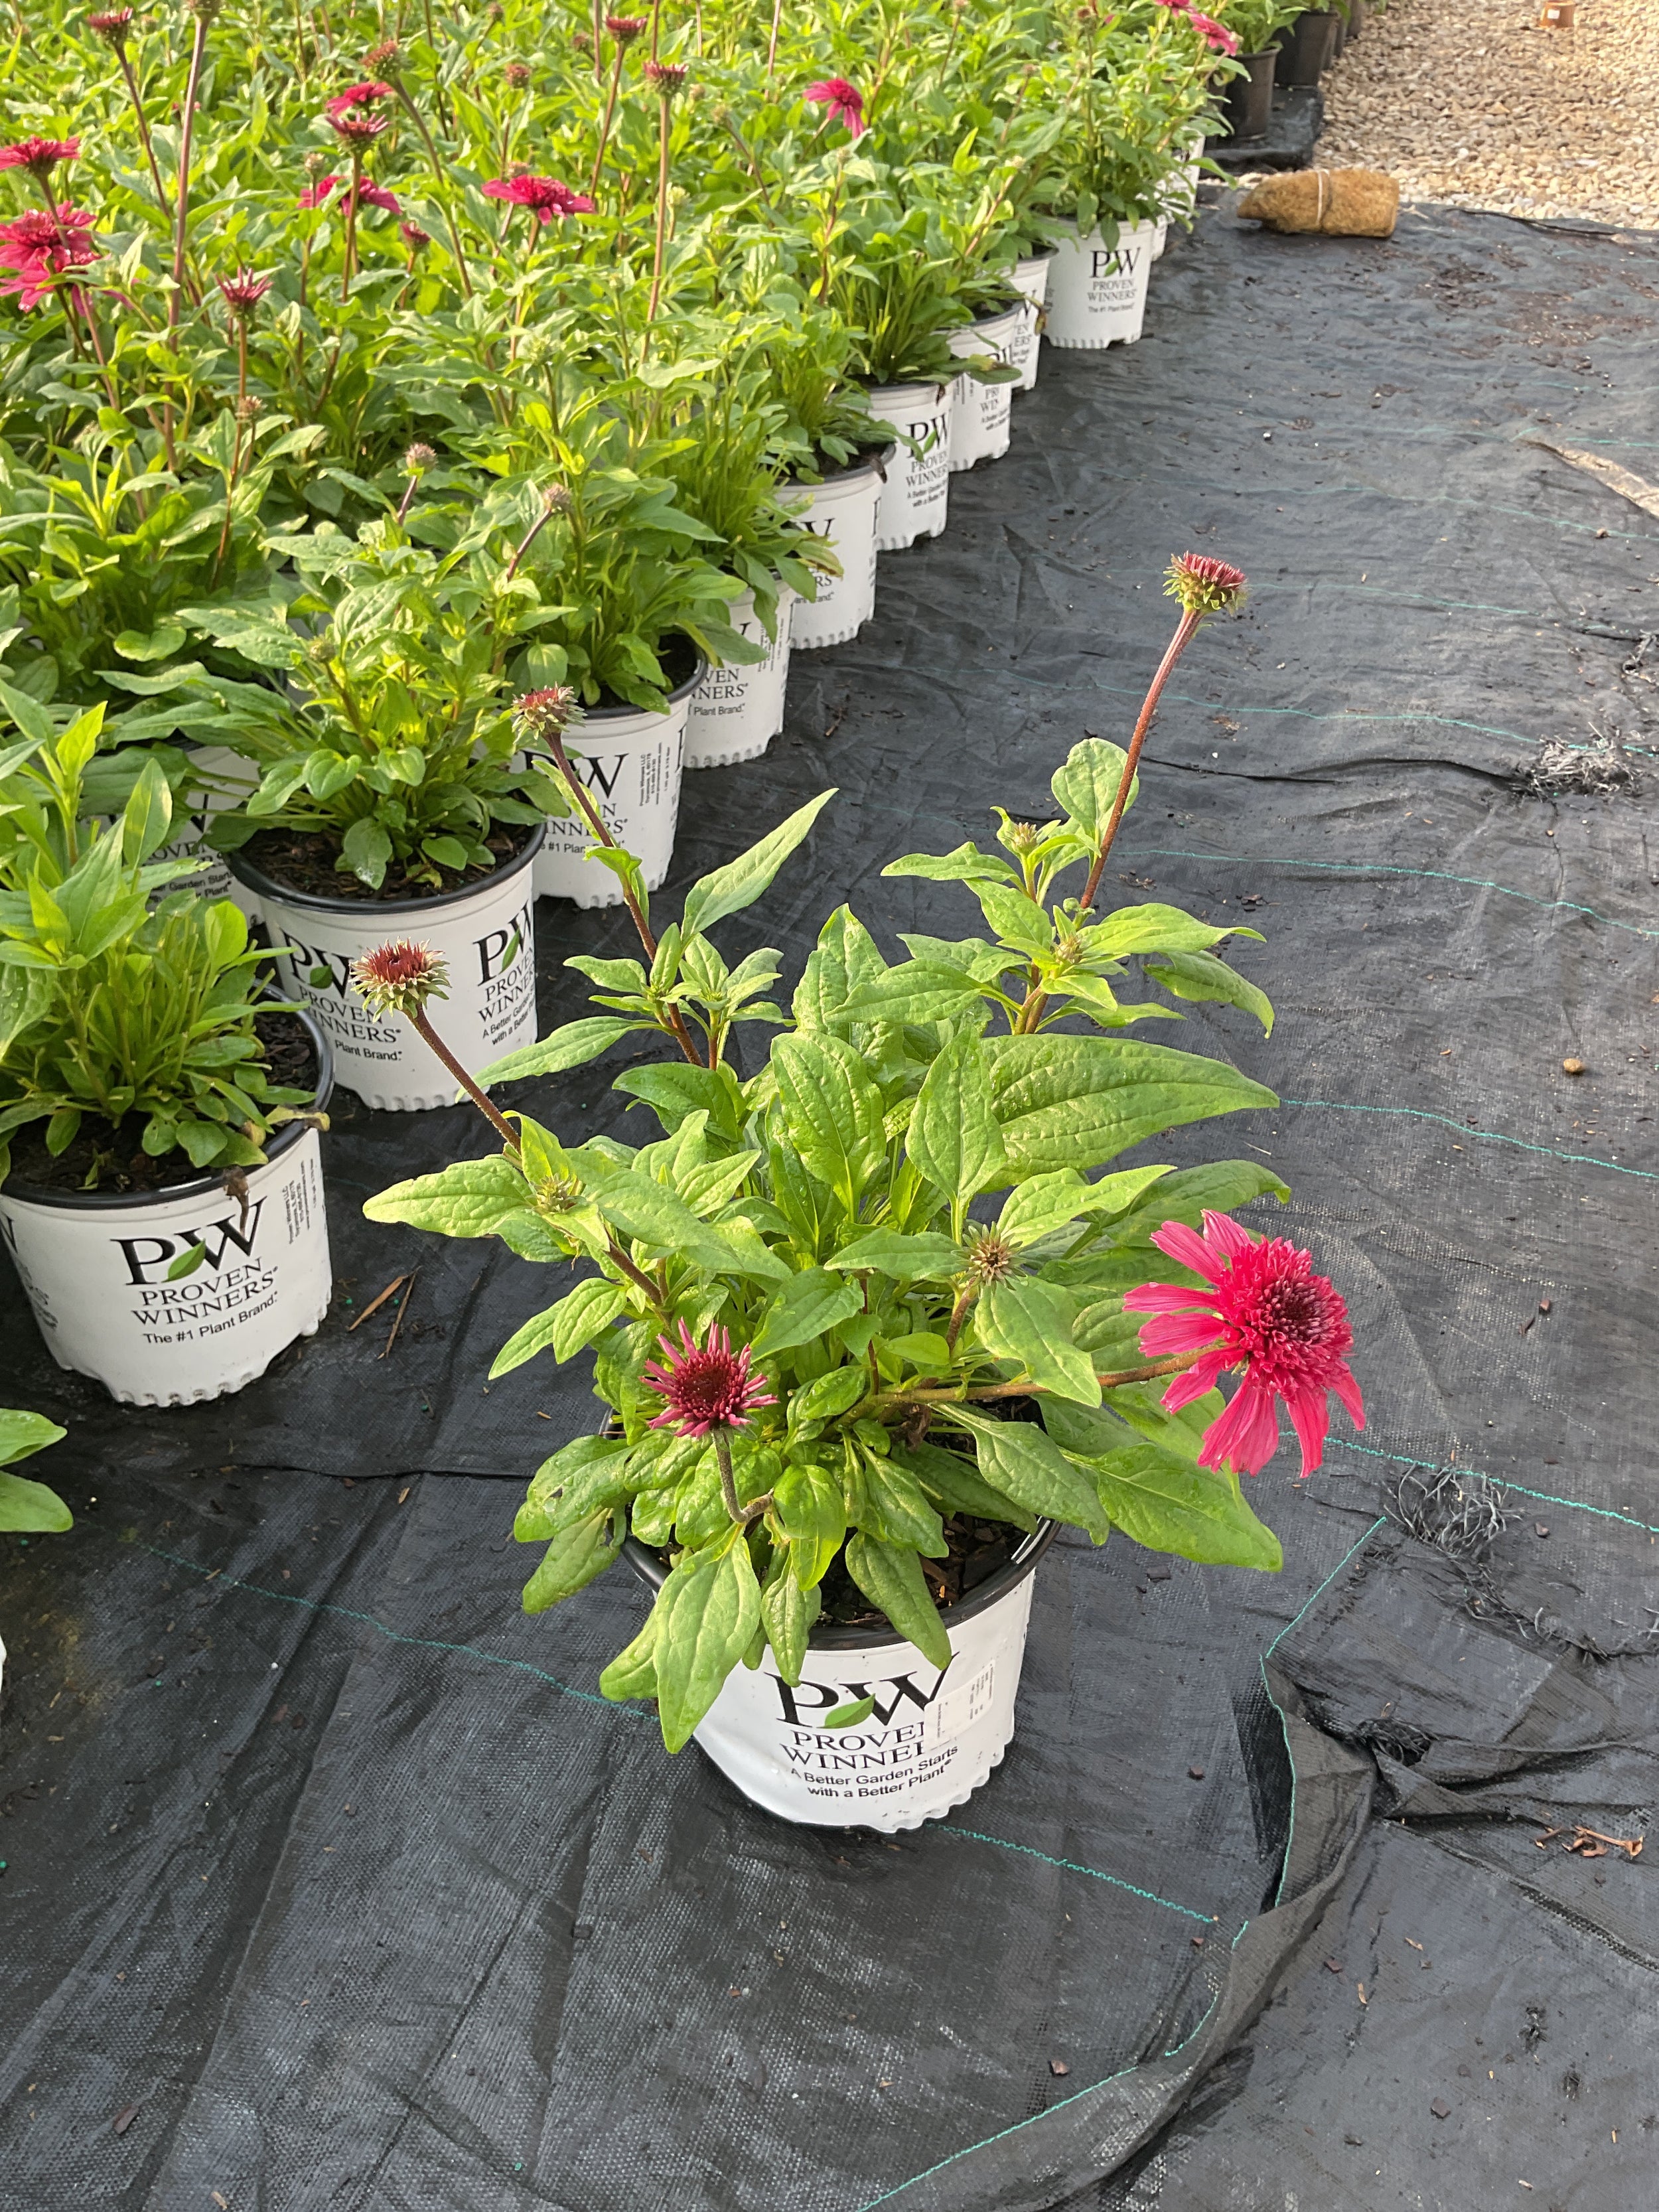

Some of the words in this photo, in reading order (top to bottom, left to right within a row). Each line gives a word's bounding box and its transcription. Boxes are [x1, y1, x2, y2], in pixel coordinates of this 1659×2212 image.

[1090, 246, 1141, 279] PW
[705, 668, 740, 683] VEN
[692, 684, 745, 700] NERS
[564, 844, 586, 853] Plan
[308, 1006, 398, 1043] INNERS
[482, 1029, 490, 1039] A
[490, 1013, 512, 1034] Better
[492, 1031, 507, 1045] with
[334, 1039, 361, 1057] Plant
[110, 1196, 267, 1286] PW
[139, 1256, 262, 1307] PROVEN
[143, 1333, 173, 1344] The
[176, 1330, 194, 1342] #1
[199, 1317, 236, 1337] Plant
[764, 1651, 960, 1728] PW
[779, 1739, 924, 1770] WINNE
[791, 1767, 802, 1779] A
[804, 1771, 851, 1785] Better
[856, 1767, 913, 1785] Garden
[918, 1745, 959, 1771] Starts
[807, 1787, 839, 1798] with
[843, 1789, 853, 1798] a
[858, 1783, 905, 1797] Better
